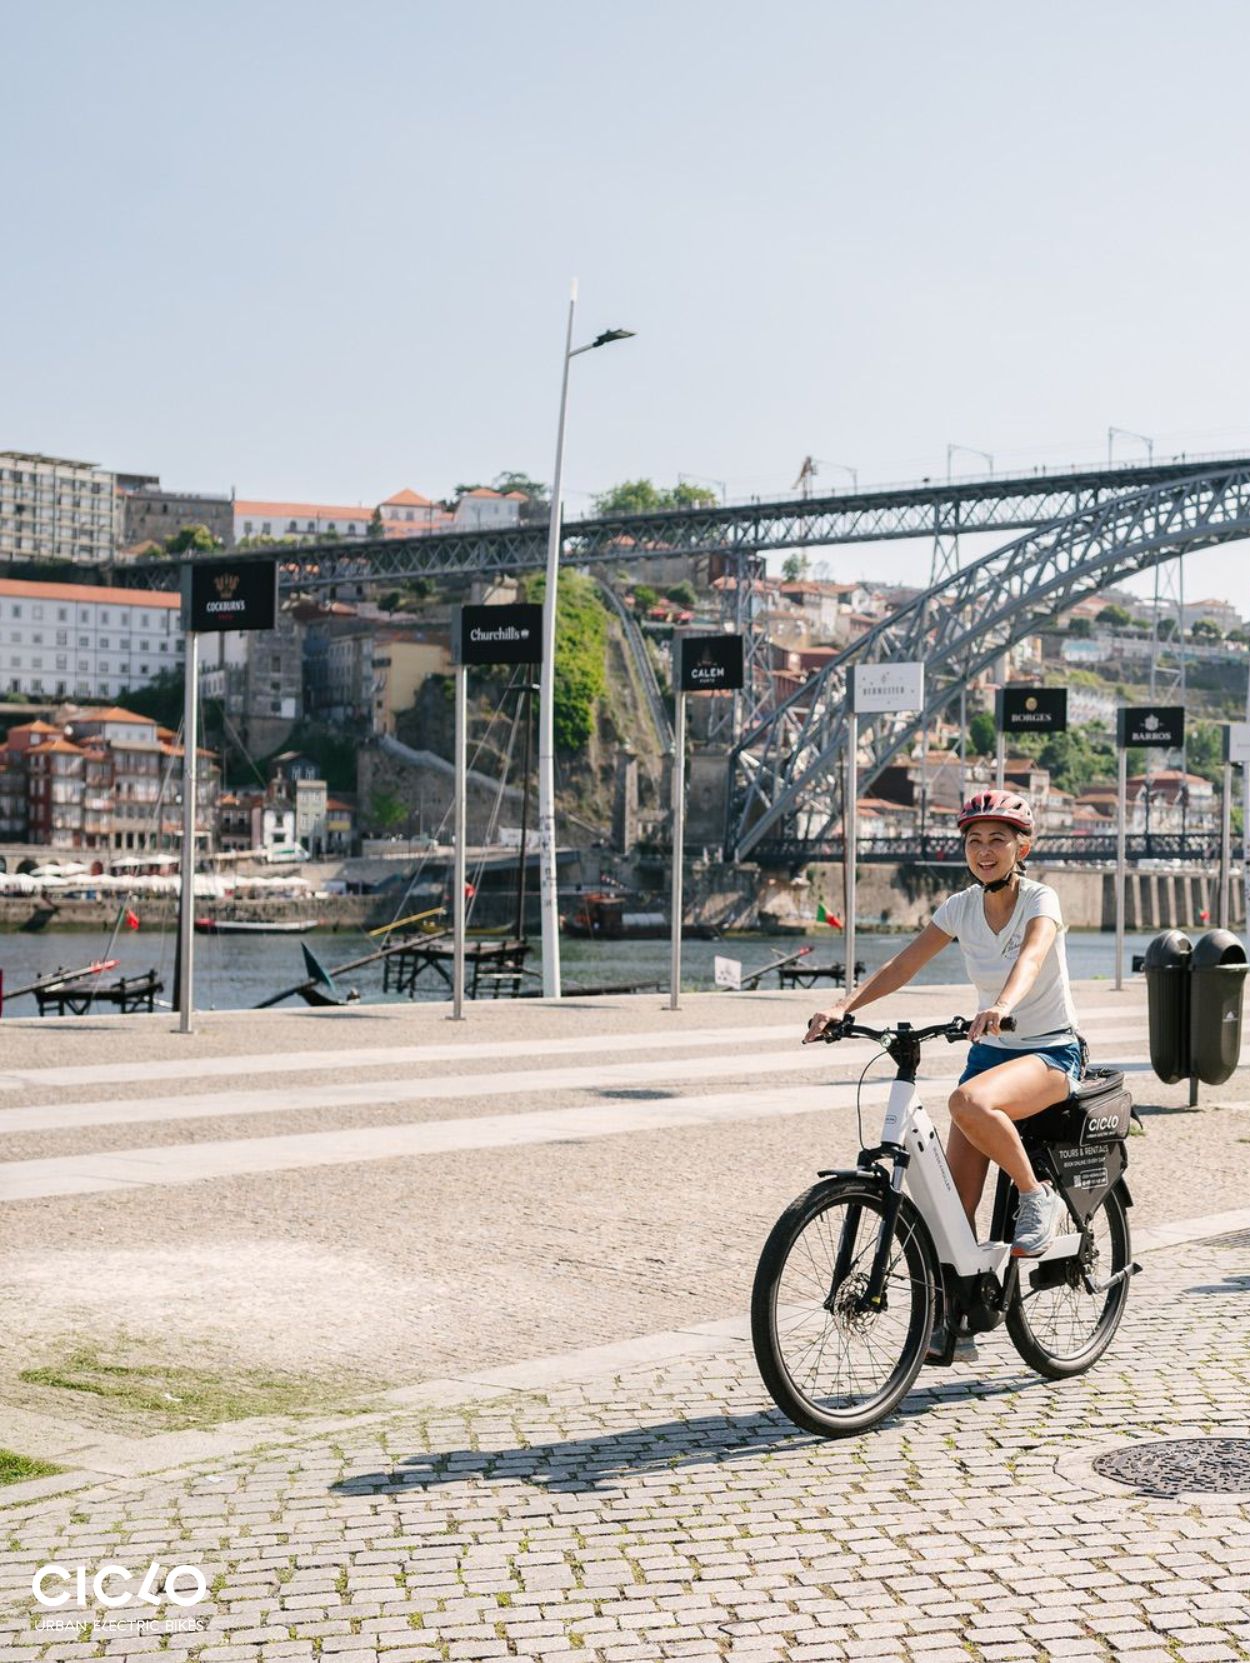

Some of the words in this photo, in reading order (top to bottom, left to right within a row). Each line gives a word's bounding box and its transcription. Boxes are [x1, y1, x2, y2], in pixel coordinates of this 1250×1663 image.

[206, 600, 245, 612] COCKBURN'S
[1011, 713, 1052, 723] BORGES
[1132, 731, 1172, 741] BARROS
[1089, 1115, 1119, 1131] CICLO
[1059, 1149, 1079, 1159] TOURS
[1080, 1149, 1084, 1157] &
[1085, 1145, 1109, 1155] RENTALS
